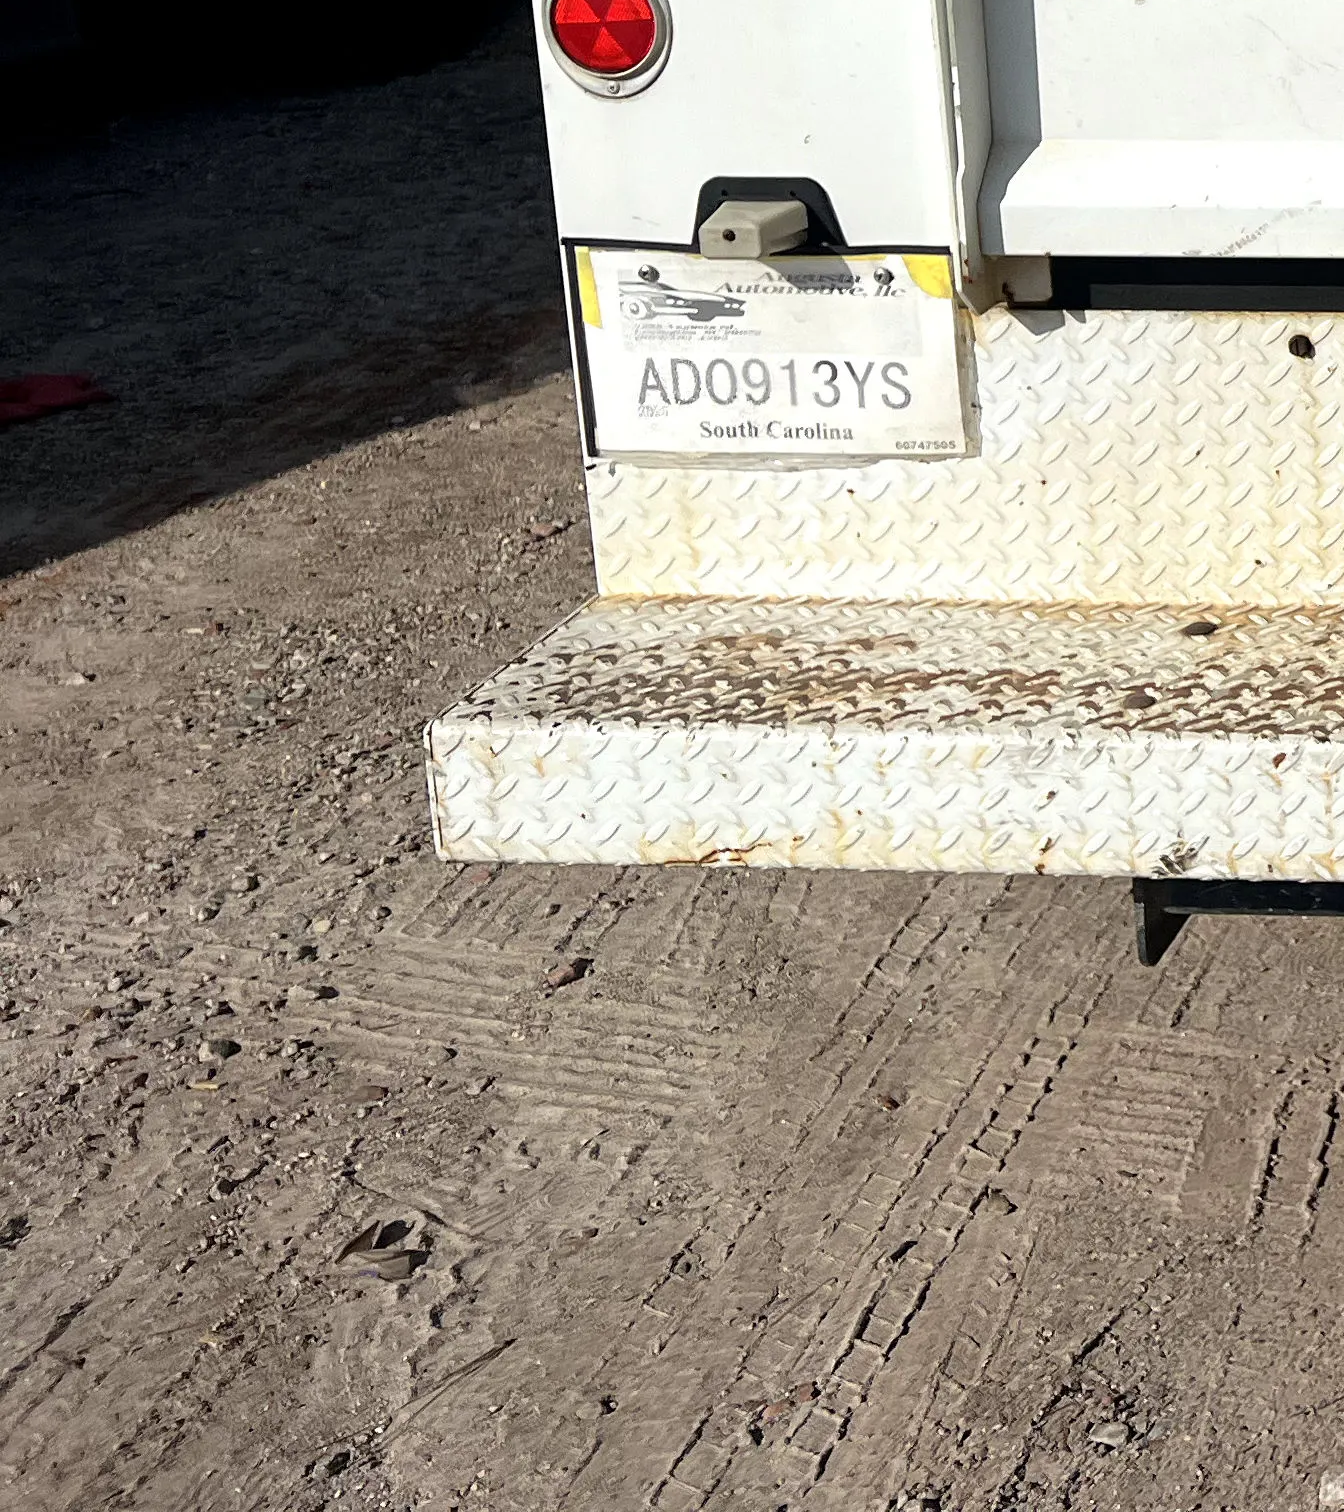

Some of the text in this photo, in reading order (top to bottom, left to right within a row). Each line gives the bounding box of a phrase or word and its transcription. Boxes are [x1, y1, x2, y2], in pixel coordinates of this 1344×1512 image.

[638, 357, 911, 409] AD0913YS
[699, 420, 854, 440] South Carolina
